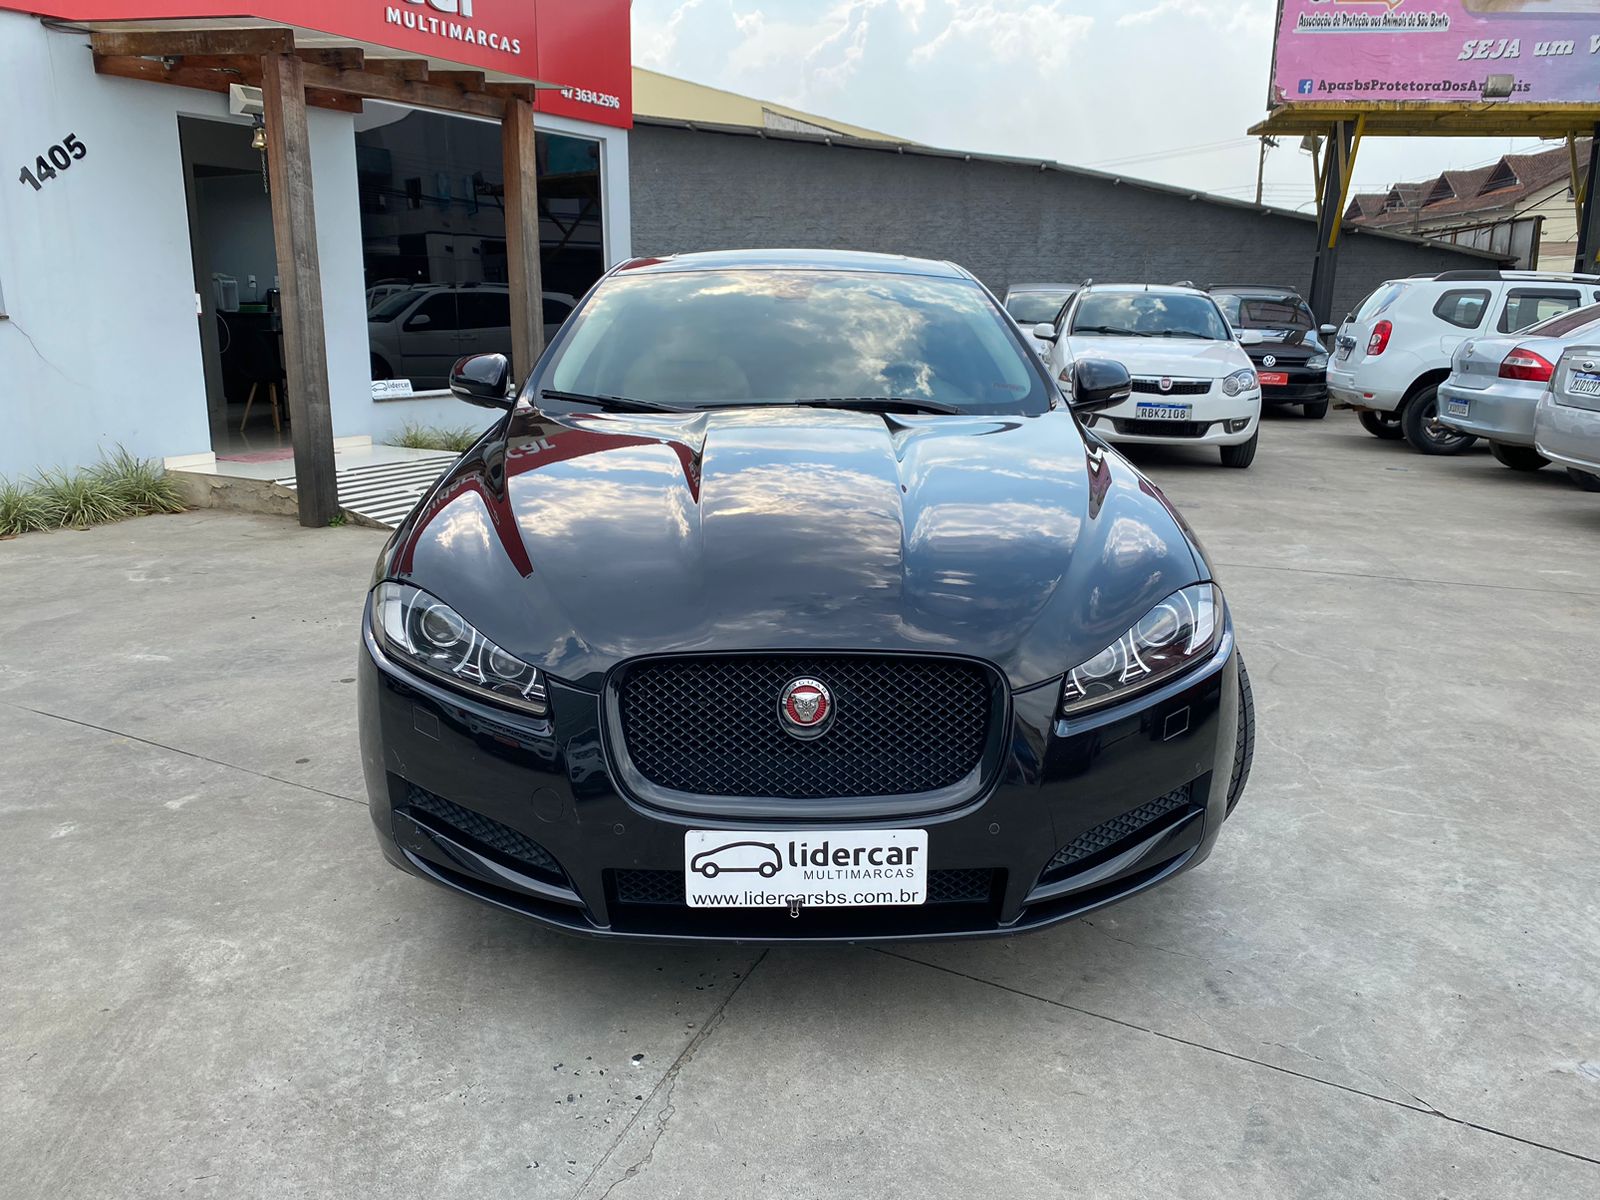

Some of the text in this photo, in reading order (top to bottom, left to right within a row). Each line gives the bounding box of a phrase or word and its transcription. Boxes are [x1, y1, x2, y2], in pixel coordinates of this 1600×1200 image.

[385, 6, 521, 54] MULTIMARCAS
[1332, 12, 1341, 28] de
[1457, 38, 1521, 61] SEJA
[1533, 40, 1576, 57] um
[575, 88, 620, 109] 3634.2596
[19, 132, 87, 191] 1405
[788, 841, 919, 867] lidercar
[803, 868, 914, 880] MULTIMARCAS
[692, 888, 919, 906] www.lidercarsbs.com.br
